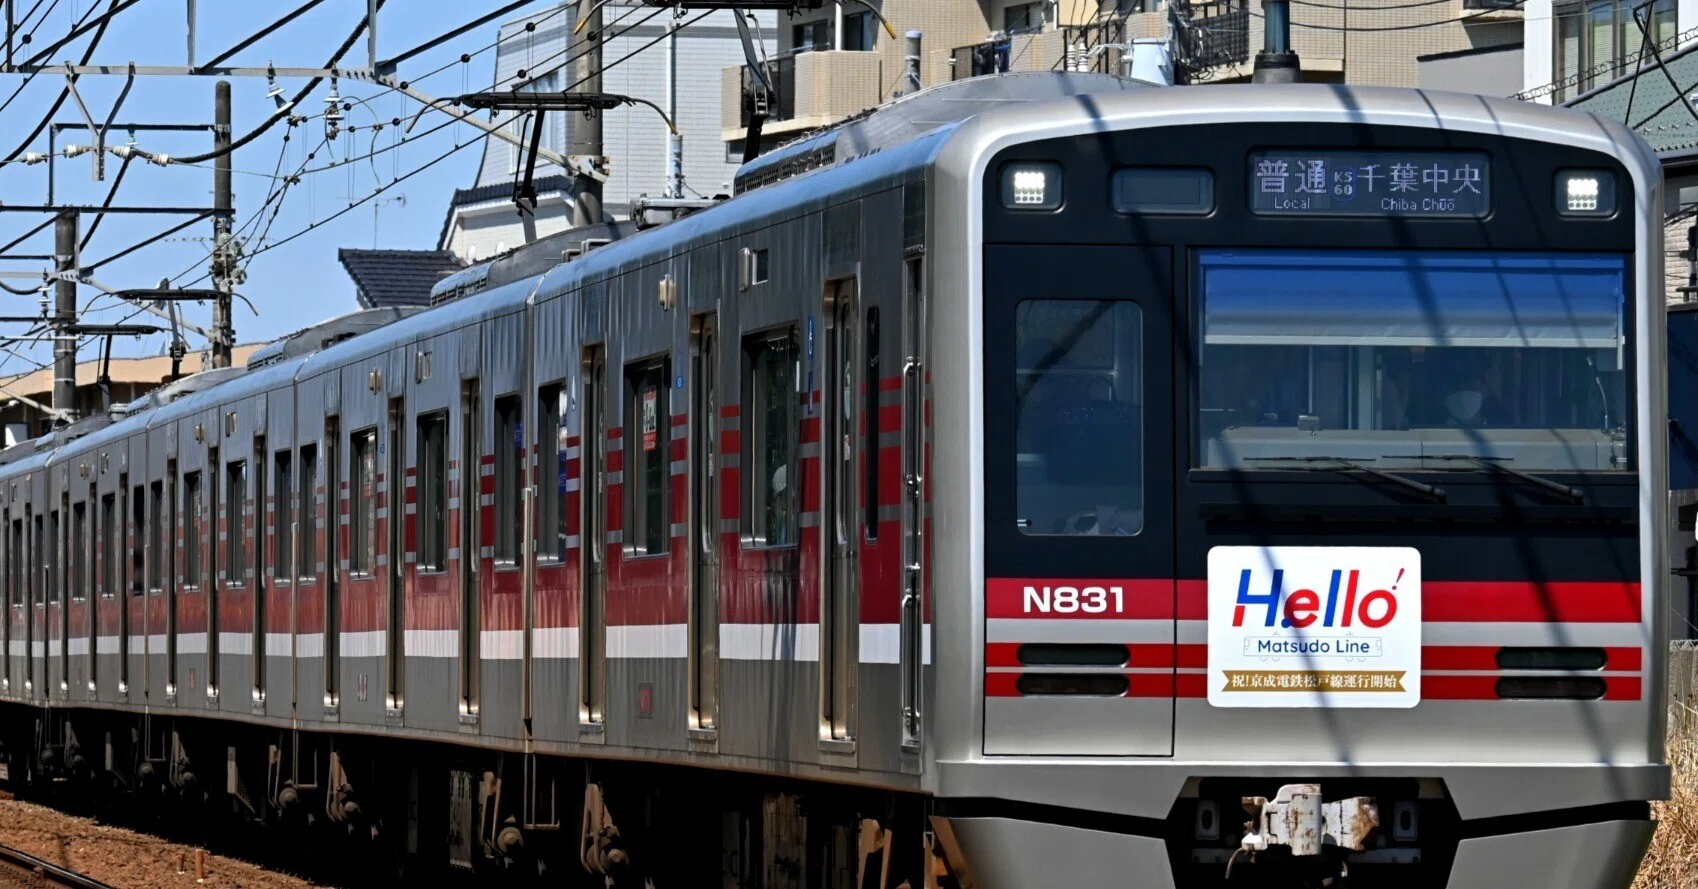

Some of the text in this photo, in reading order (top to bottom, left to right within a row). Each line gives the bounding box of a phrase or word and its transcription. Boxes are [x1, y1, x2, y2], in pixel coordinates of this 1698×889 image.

[1256, 160, 1327, 194] 普通
[1334, 171, 1354, 183] KS
[1357, 163, 1482, 194] 千葉中央
[1334, 184, 1354, 196] 60
[1274, 196, 1311, 209] Local
[1381, 198, 1417, 211] Chiba
[1023, 586, 1124, 613] N831
[1258, 638, 1371, 655] Matsudo Line
